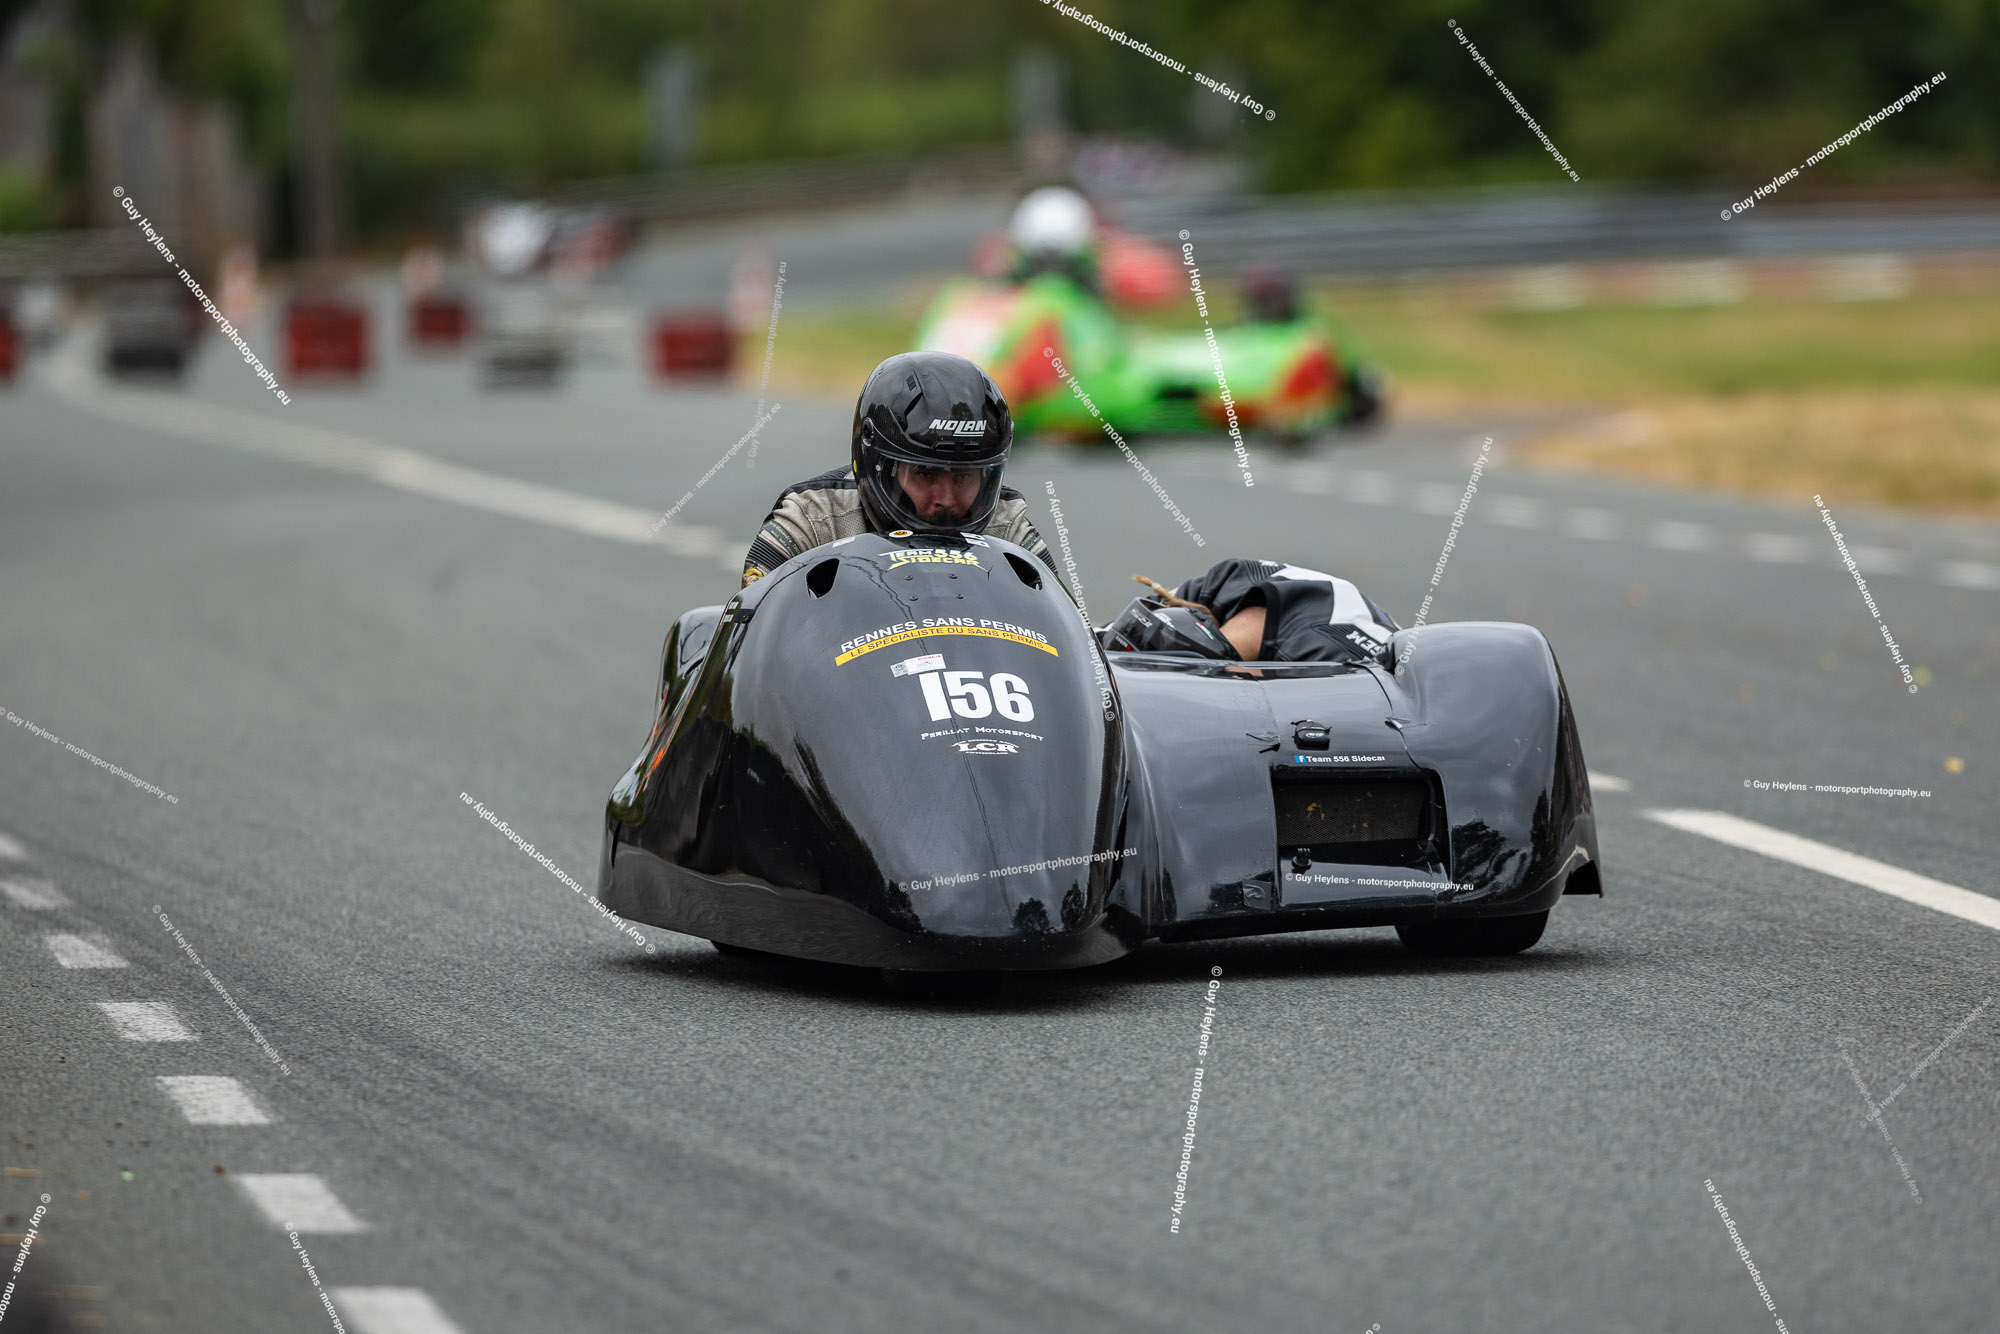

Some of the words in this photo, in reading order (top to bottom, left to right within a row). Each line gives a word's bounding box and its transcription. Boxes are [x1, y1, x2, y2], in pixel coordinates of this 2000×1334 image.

[929, 418, 987, 437] NOLAN
[933, 549, 978, 560] 556
[887, 555, 990, 573] SIDECAR
[840, 621, 916, 653] RENNES
[922, 617, 976, 627] SANS
[980, 619, 1048, 644] PERMIS
[850, 648, 864, 657] LE
[967, 628, 1000, 637] SANS
[1002, 631, 1044, 649] PERMIS
[919, 671, 1035, 722] 156
[959, 744, 1019, 753] LCR
[1306, 755, 1332, 763] Team
